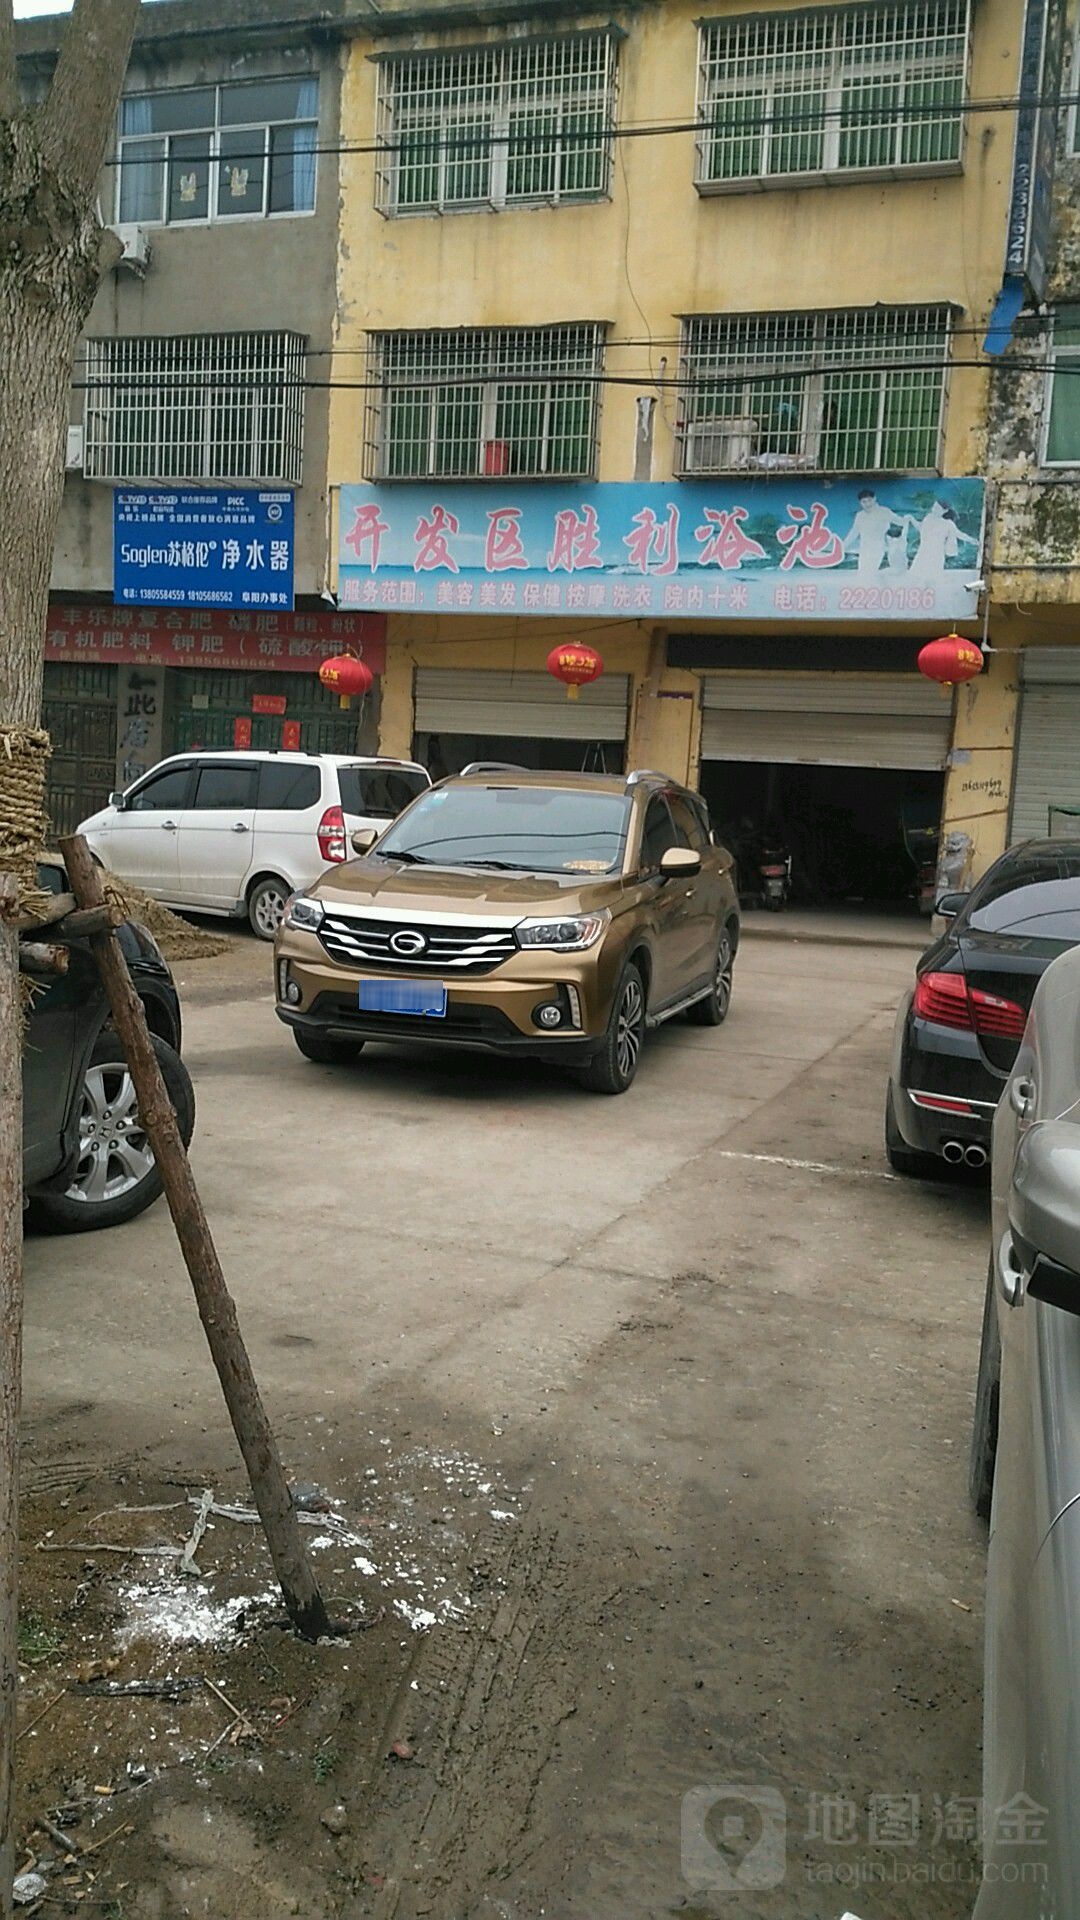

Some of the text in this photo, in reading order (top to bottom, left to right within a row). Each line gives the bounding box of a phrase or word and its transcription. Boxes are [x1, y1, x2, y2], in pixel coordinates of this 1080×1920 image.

[227, 496, 245, 506] PICC
[345, 502, 845, 576] 开发区胜利浴池
[222, 539, 289, 571] 净水器
[241, 592, 288, 604] 阜阳办事处
[479, 582, 517, 606] 美发
[523, 582, 561, 608] 保健
[567, 583, 606, 608] 按摩
[613, 584, 651, 608] 洗衣
[663, 584, 749, 610] 院内十米
[62, 608, 213, 630] 丰乐牌复合肥
[48, 629, 153, 650] 有机肥料
